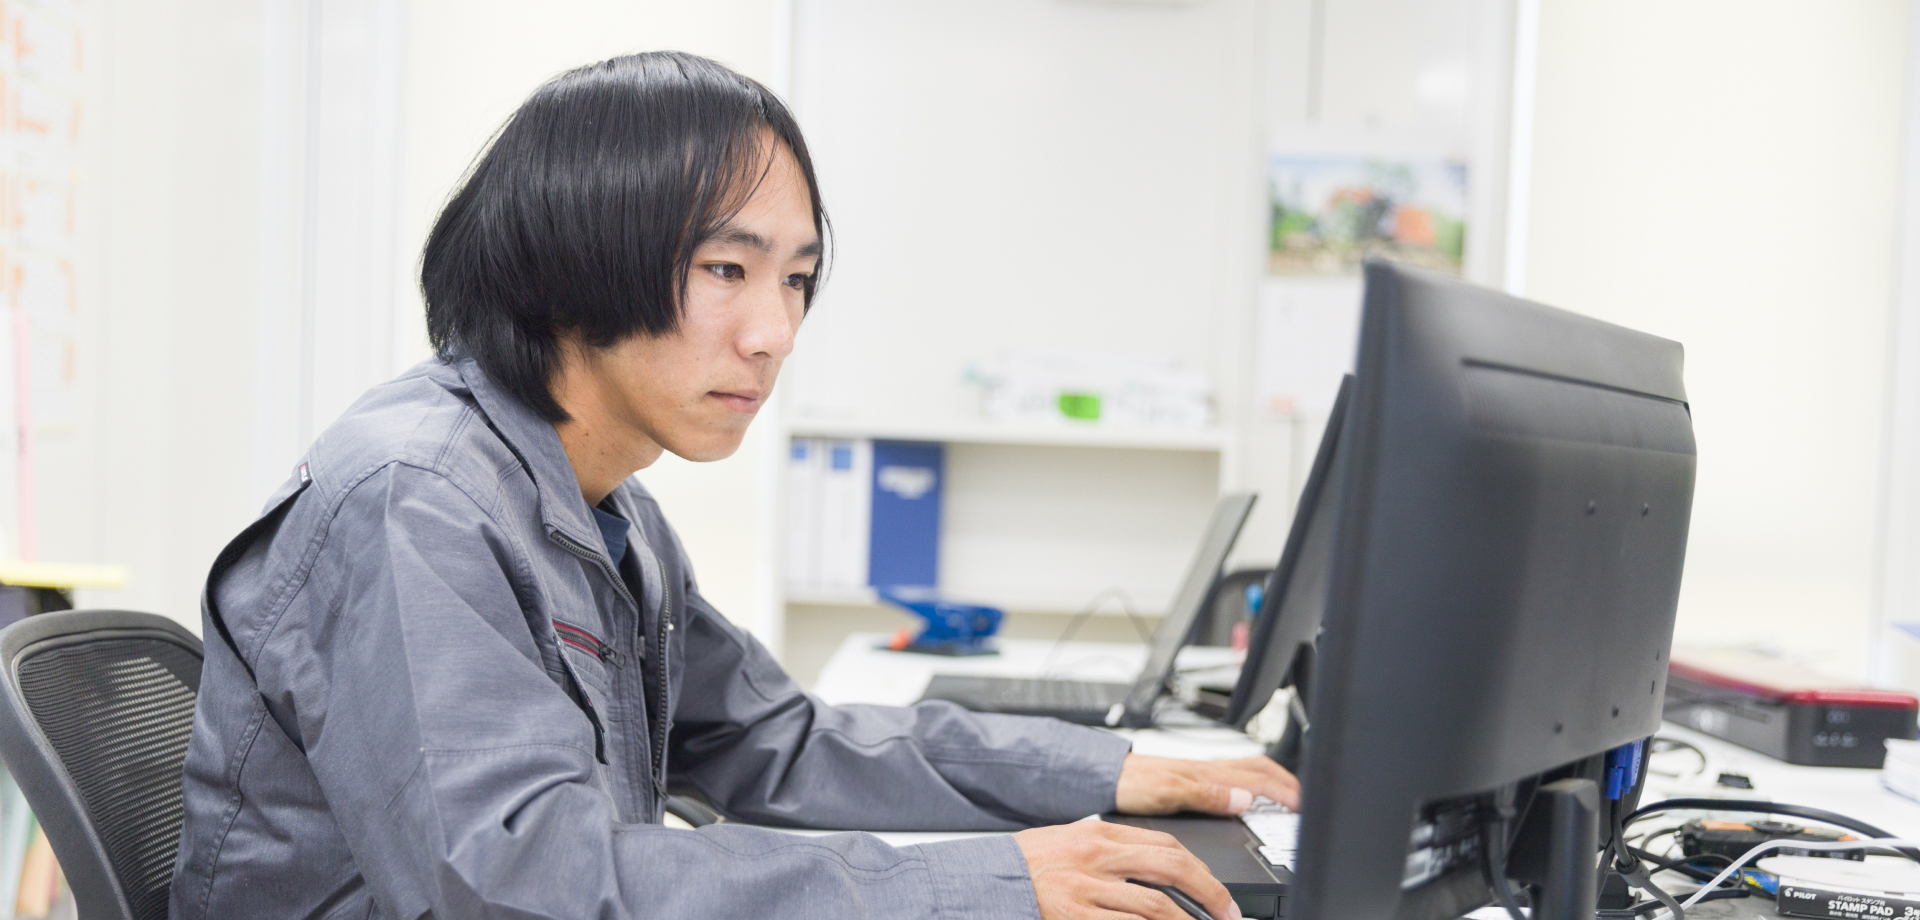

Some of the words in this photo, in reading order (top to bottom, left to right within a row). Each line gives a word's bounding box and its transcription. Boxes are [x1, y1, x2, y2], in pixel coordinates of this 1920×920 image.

[1793, 891, 1817, 900] PILOT
[1828, 900, 1868, 912] STAMP
[1870, 905, 1893, 917] PAD
